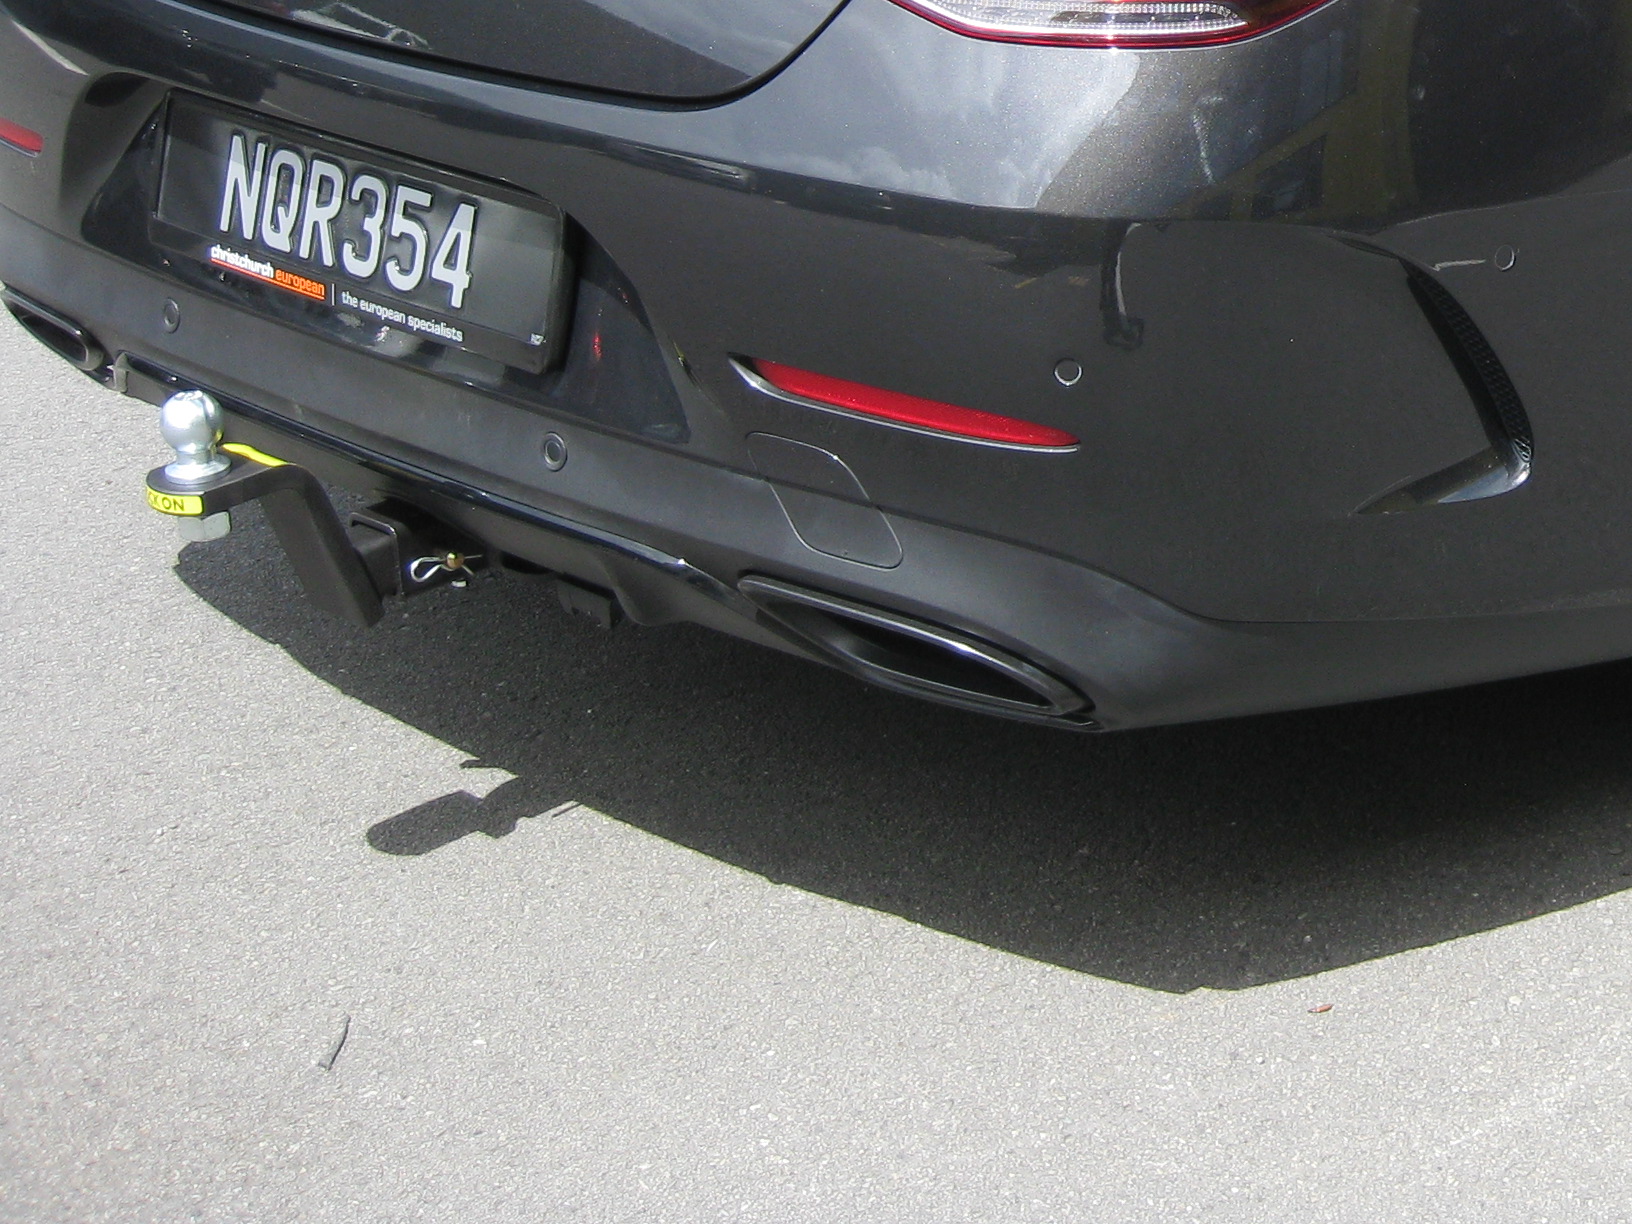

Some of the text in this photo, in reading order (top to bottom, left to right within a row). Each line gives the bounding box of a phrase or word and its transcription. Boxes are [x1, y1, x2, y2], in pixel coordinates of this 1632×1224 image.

[219, 134, 478, 309] NQR354
[210, 244, 326, 298] christchurch european
[341, 290, 464, 343] the european specialists
